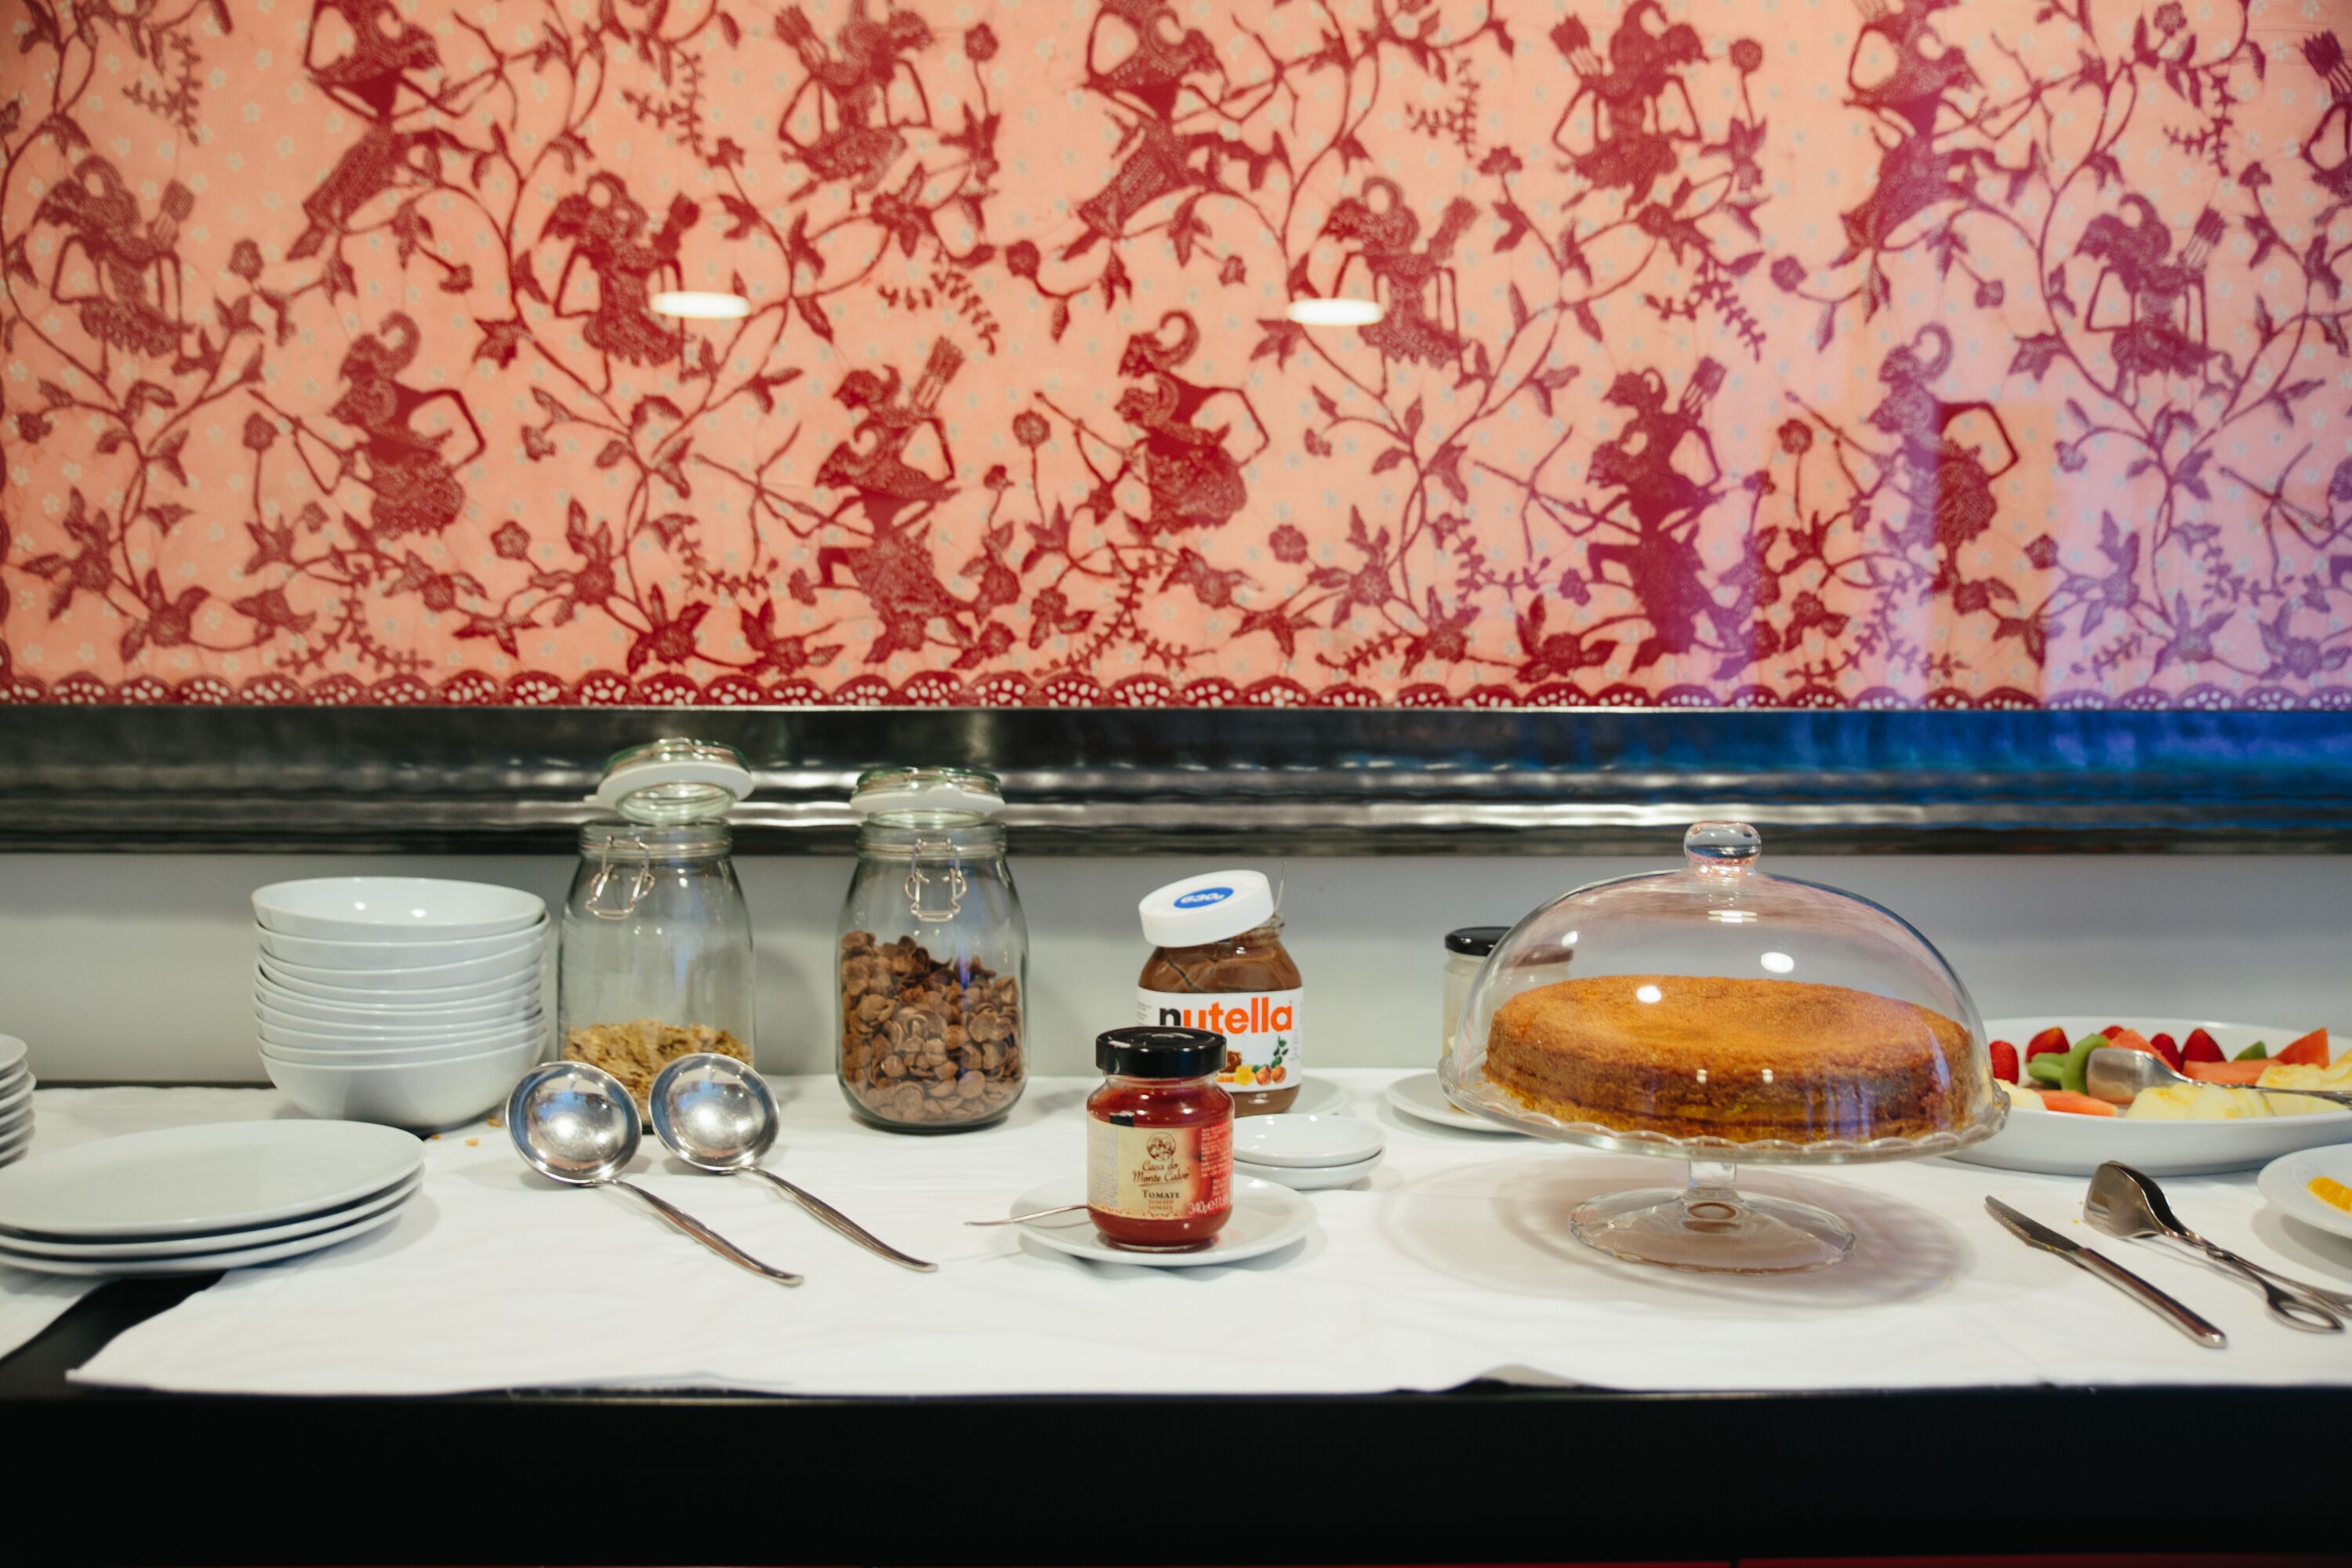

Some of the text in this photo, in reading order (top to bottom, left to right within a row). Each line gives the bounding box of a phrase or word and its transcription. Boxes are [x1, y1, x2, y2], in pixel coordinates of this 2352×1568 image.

[1159, 996, 1293, 1034] nutella
[1142, 1160, 1164, 1171] Casa
[1132, 1170, 1161, 1182] Monte
[1142, 1189, 1180, 1199] TOMATE
